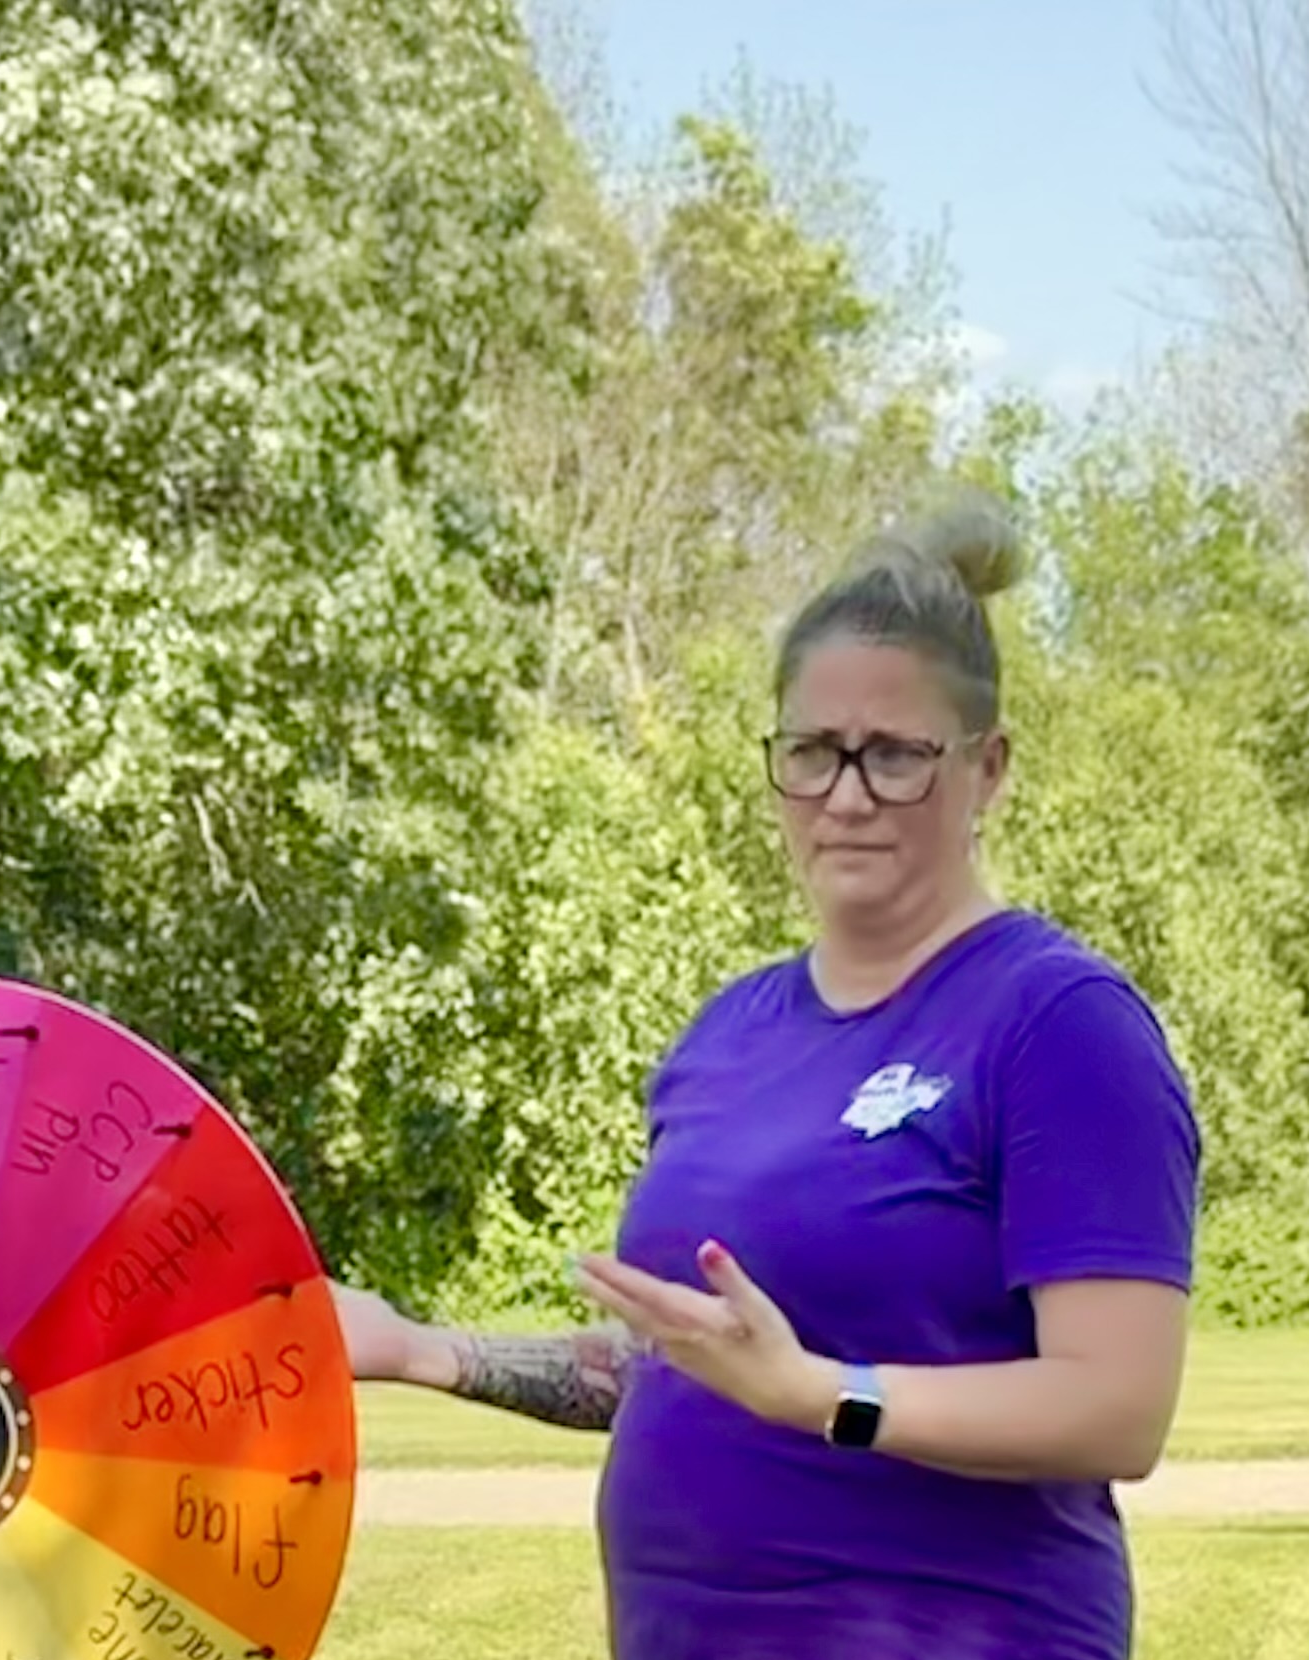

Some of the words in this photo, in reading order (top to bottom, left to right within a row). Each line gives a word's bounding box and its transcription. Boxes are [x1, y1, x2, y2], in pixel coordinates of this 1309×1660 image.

[10, 1101, 80, 1175] pin
[91, 1195, 234, 1323] tattoo
[122, 1344, 304, 1432] sticker
[175, 1474, 299, 1588] flag
